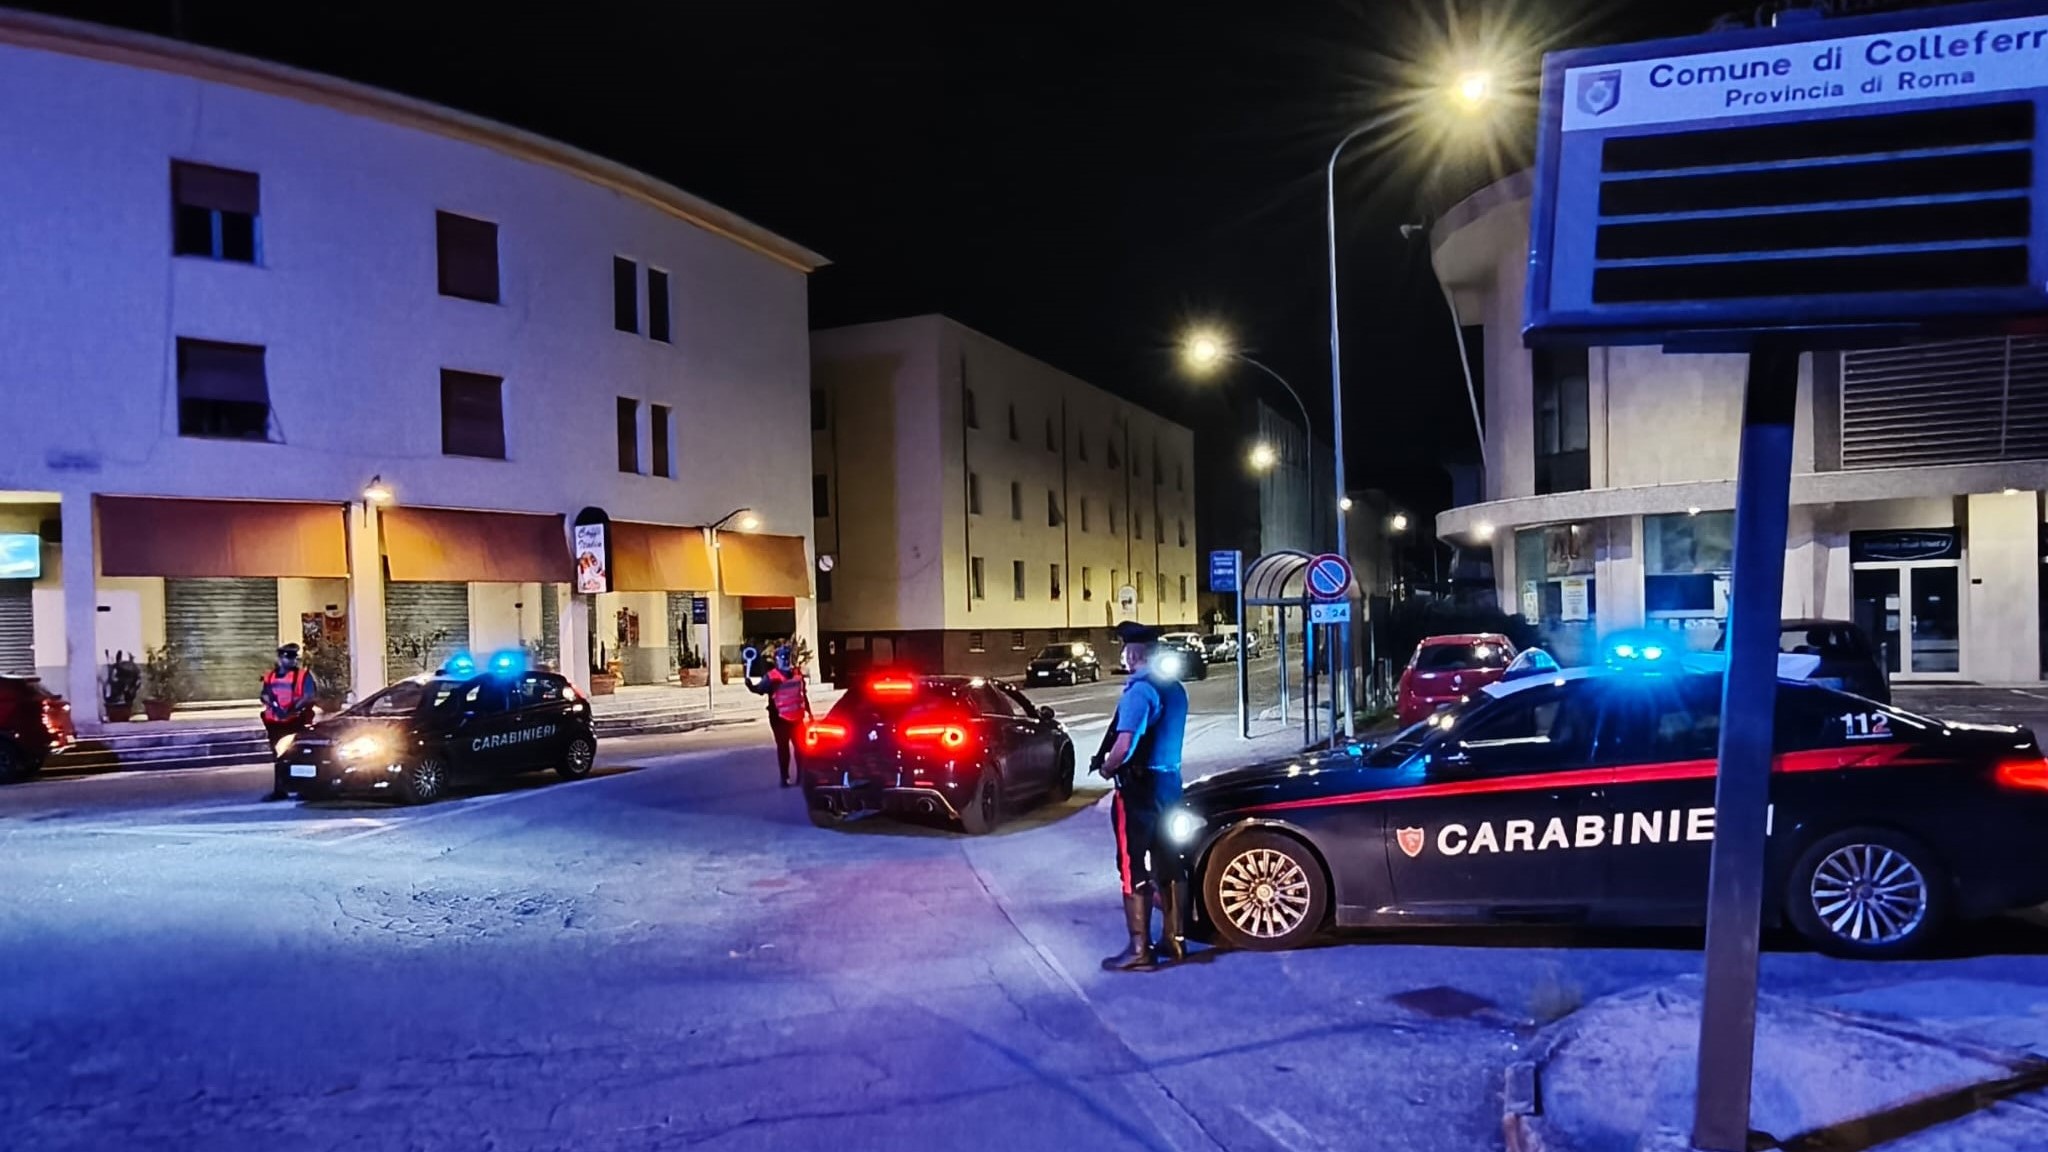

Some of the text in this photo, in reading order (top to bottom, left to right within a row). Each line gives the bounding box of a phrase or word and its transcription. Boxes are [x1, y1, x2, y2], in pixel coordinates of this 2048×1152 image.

[1649, 56, 1792, 88] Comune
[1813, 46, 1841, 72] di
[1725, 67, 1975, 108] Provincia di Roma
[1332, 609, 1346, 618] 24
[472, 724, 556, 752] CARABINIERI
[1840, 712, 1890, 733] 112
[1436, 803, 1774, 856] CARABINIEI
